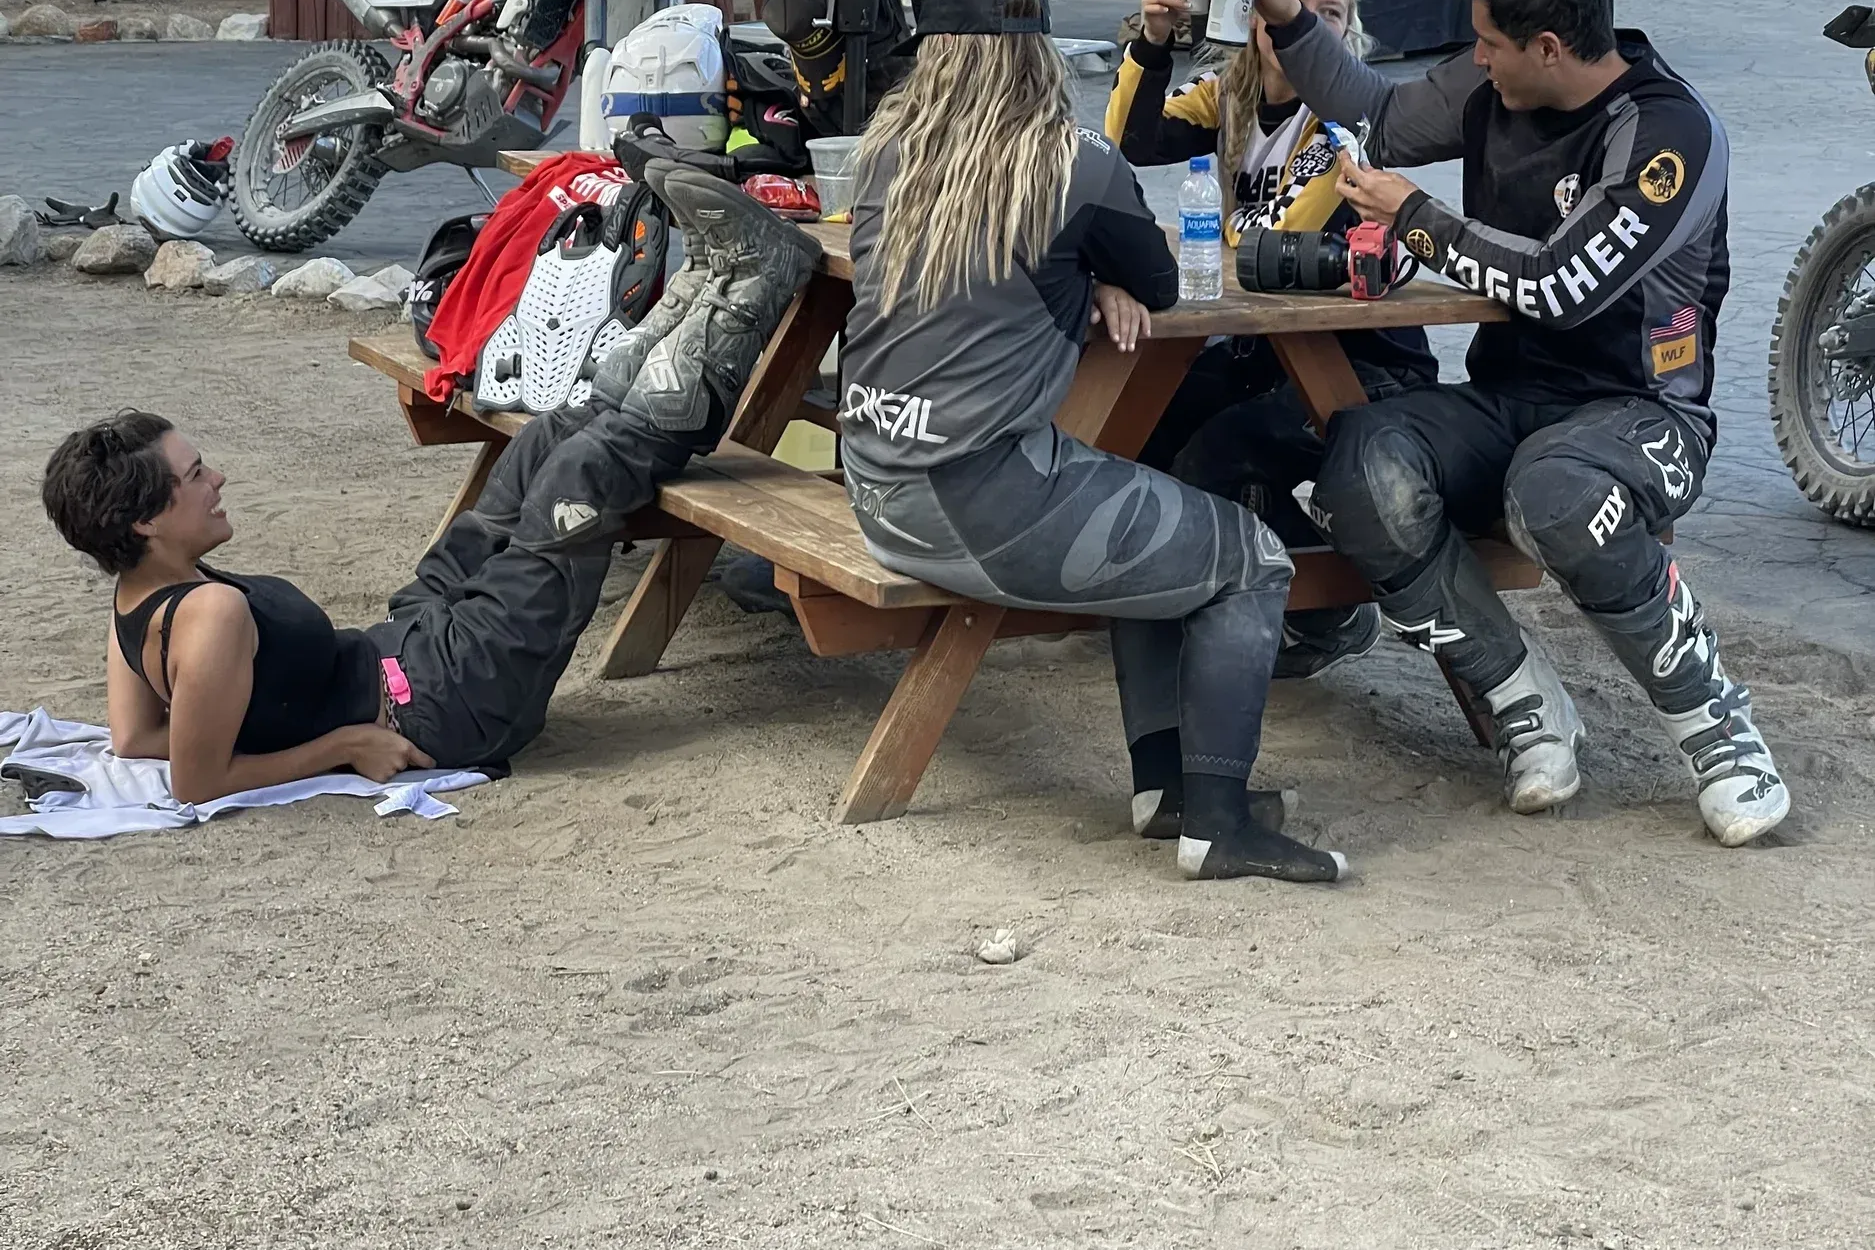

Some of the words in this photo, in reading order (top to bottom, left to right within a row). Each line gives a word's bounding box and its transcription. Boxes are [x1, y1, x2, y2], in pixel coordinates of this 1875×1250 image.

[1186, 218, 1219, 230] AQUAFINA
[1440, 206, 1650, 319] TOGETHER
[1661, 345, 1686, 363] WLF
[1310, 504, 1333, 533] OX
[1587, 485, 1627, 547] FOX
